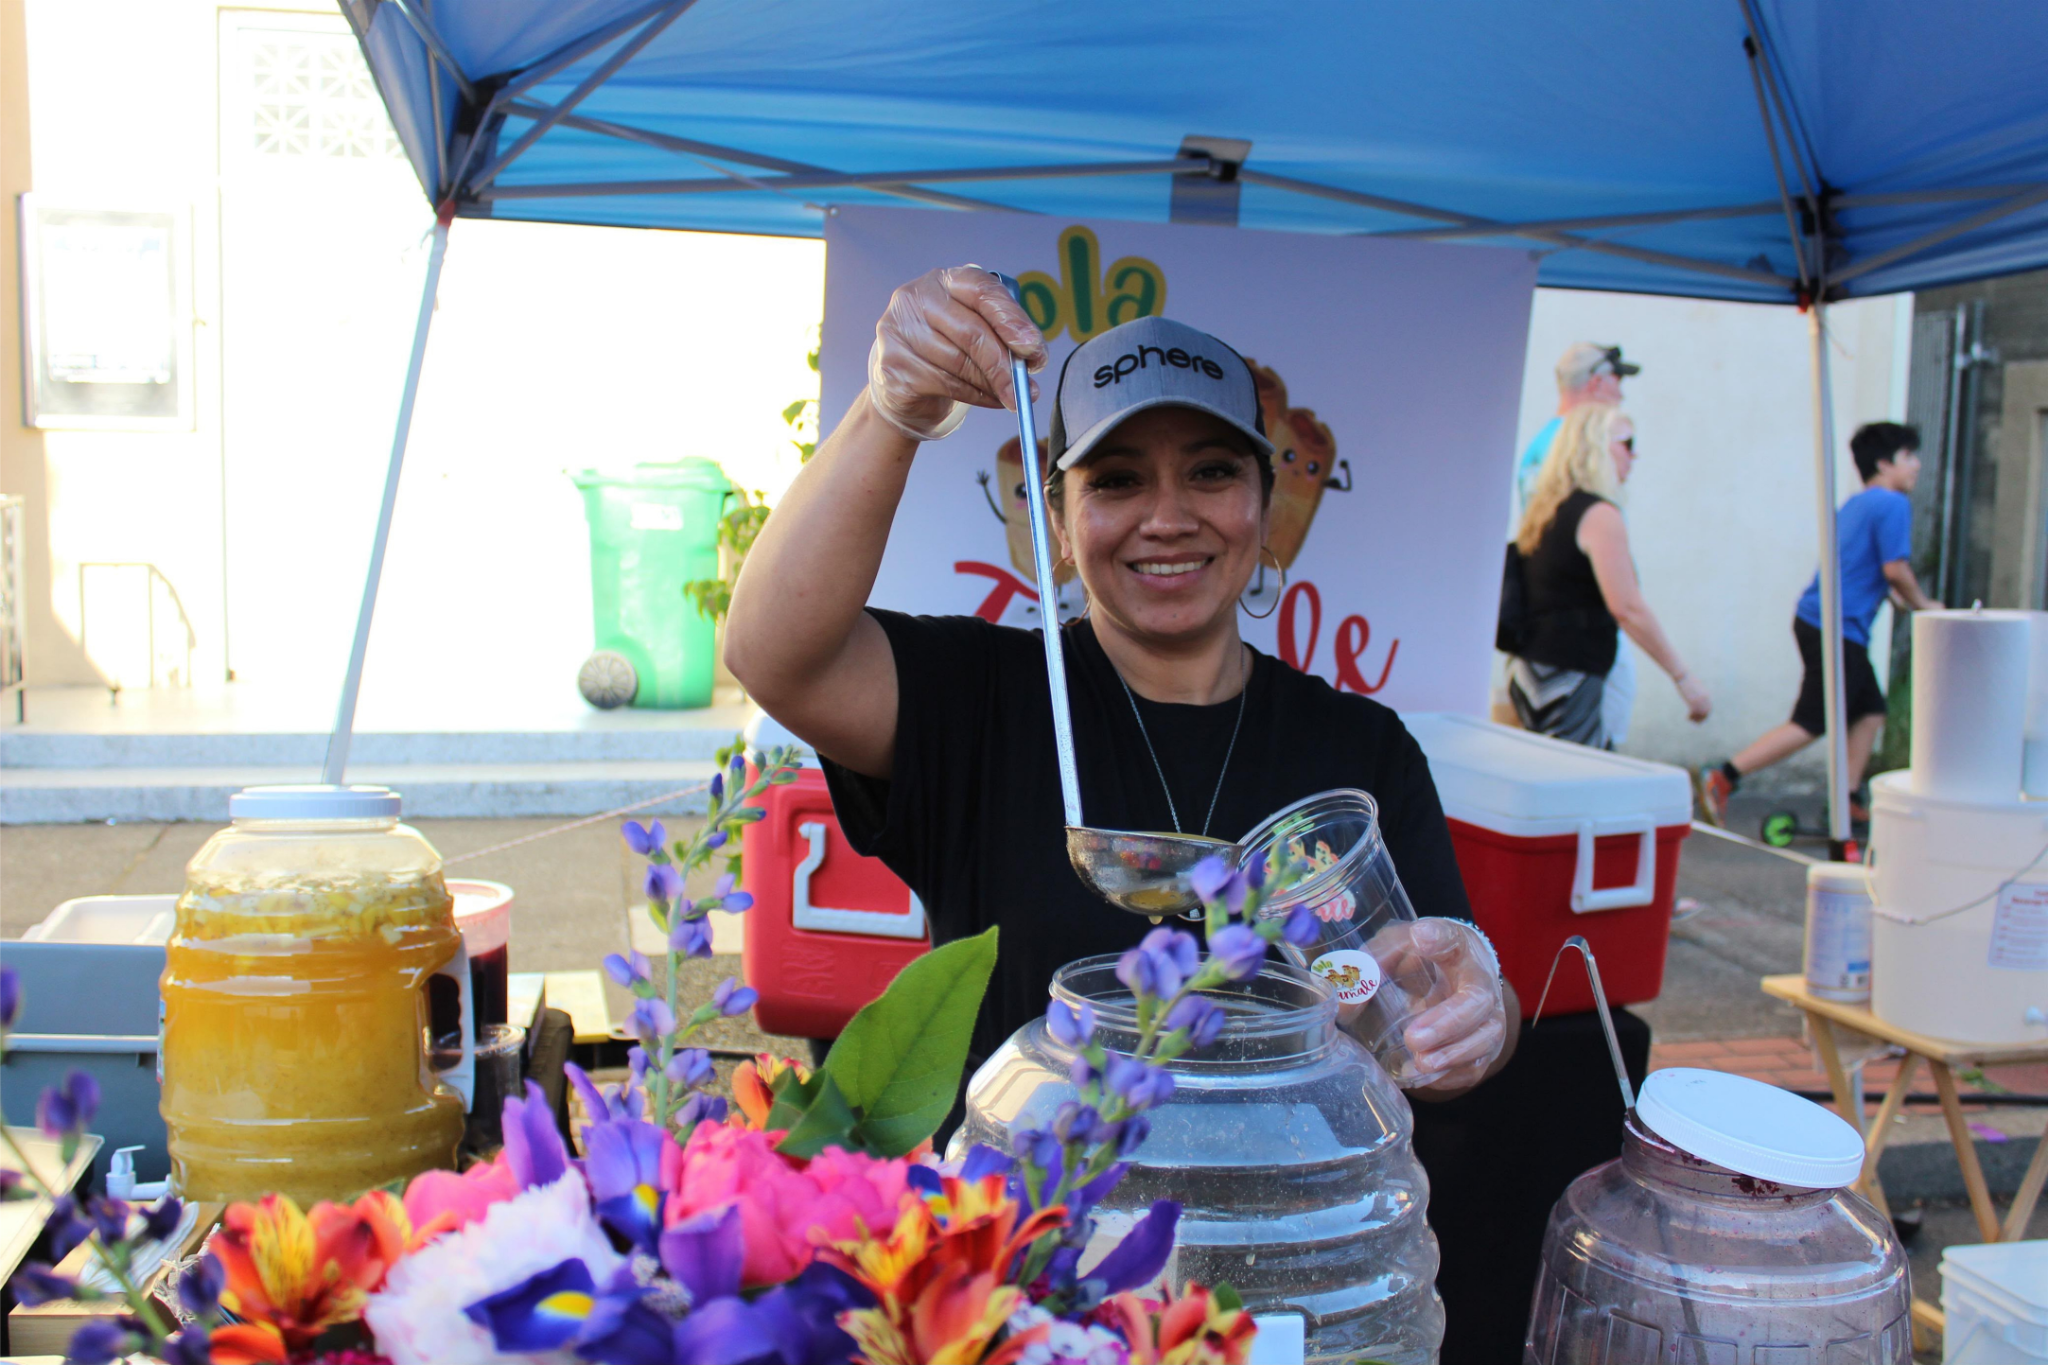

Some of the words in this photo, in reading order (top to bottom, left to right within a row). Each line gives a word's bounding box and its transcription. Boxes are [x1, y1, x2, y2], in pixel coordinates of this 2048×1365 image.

[1016, 224, 1167, 343] ola
[1093, 344, 1224, 389] sphere
[1337, 979, 1378, 1000] amale
